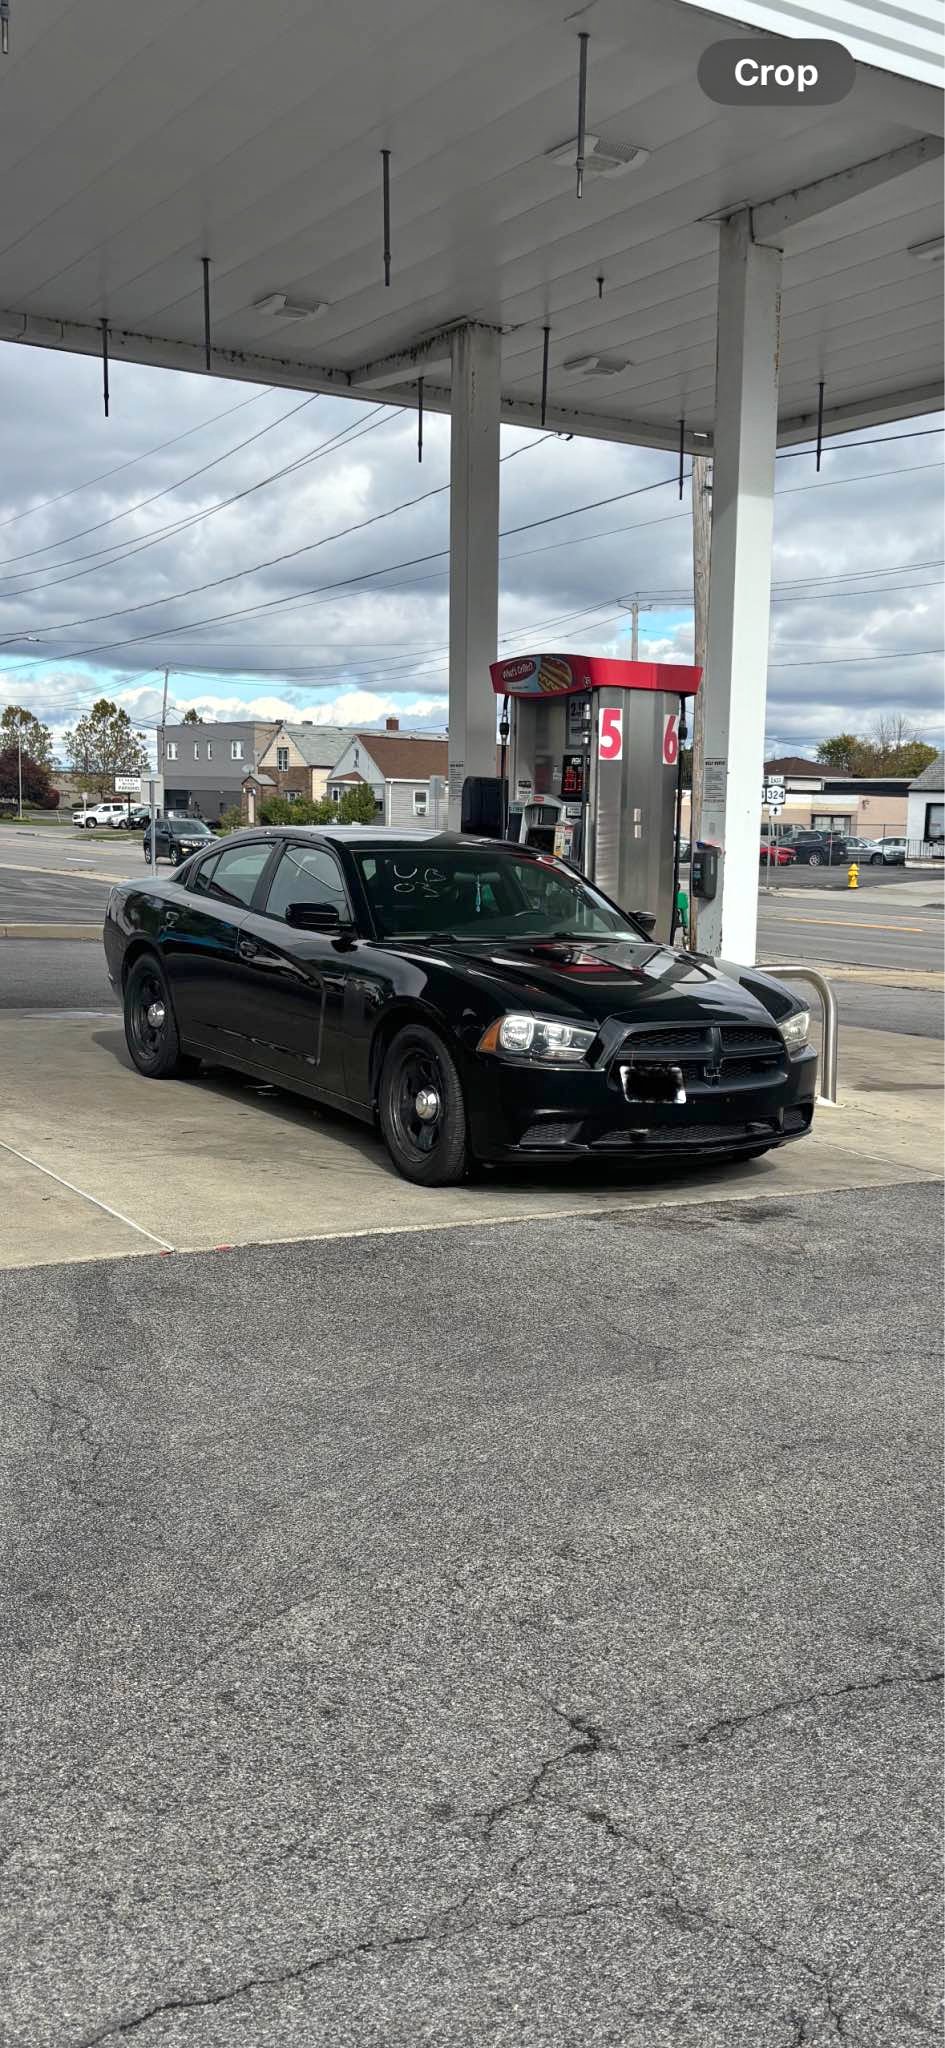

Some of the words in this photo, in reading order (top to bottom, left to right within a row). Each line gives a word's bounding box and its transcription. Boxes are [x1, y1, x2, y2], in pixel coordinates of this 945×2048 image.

[599, 708, 622, 759] 5
[664, 715, 679, 764] 6
[767, 790, 784, 800] 324
